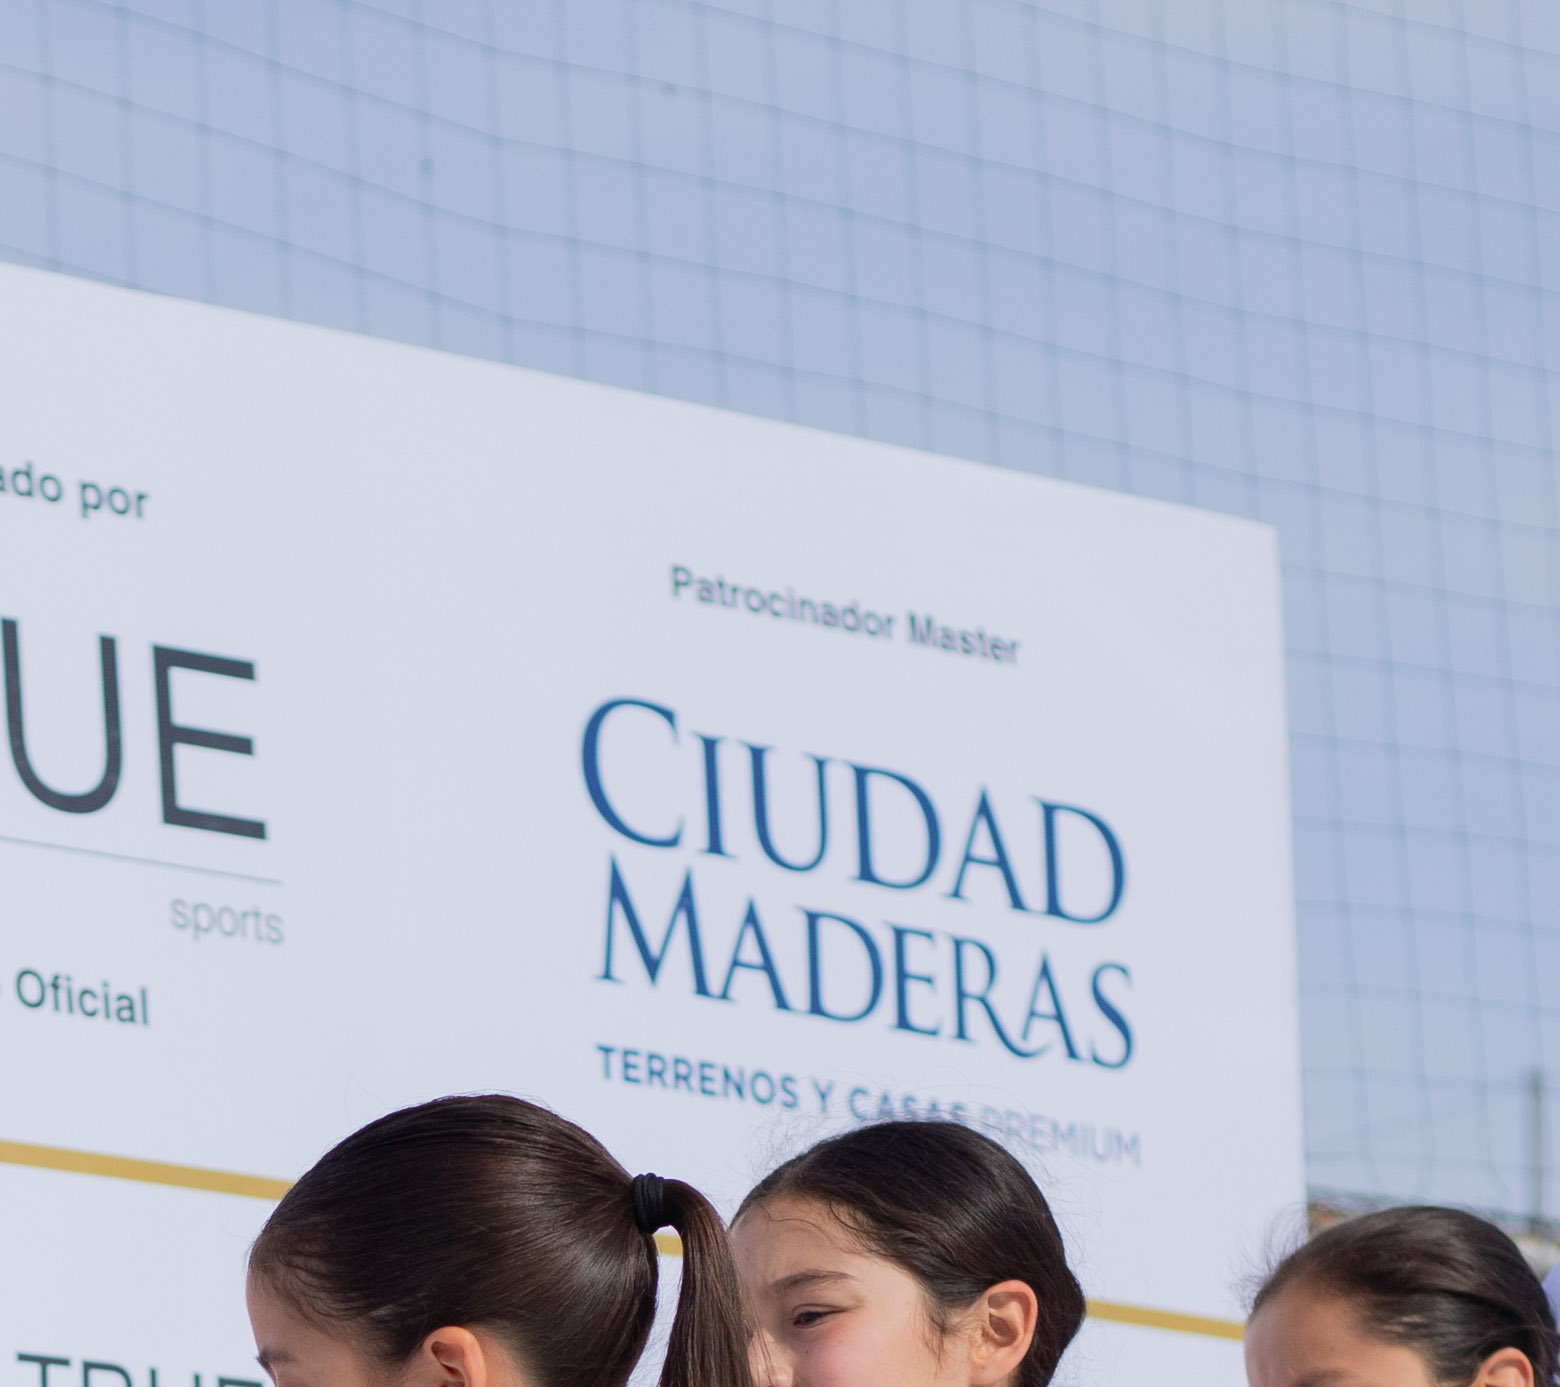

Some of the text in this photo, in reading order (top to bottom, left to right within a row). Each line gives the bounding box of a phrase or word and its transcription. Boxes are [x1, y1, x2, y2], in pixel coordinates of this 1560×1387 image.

[79, 479, 147, 519] por
[670, 565, 1019, 666] Patrocinador Master
[581, 698, 1126, 925] CIUDAD
[171, 897, 283, 944] sports
[595, 853, 1133, 1070] MADERAS
[17, 969, 148, 1026] Oficial
[596, 1045, 798, 1110] TERRENOS
[812, 1080, 834, 1113] Y
[981, 1106, 1143, 1166] PREMIUM
